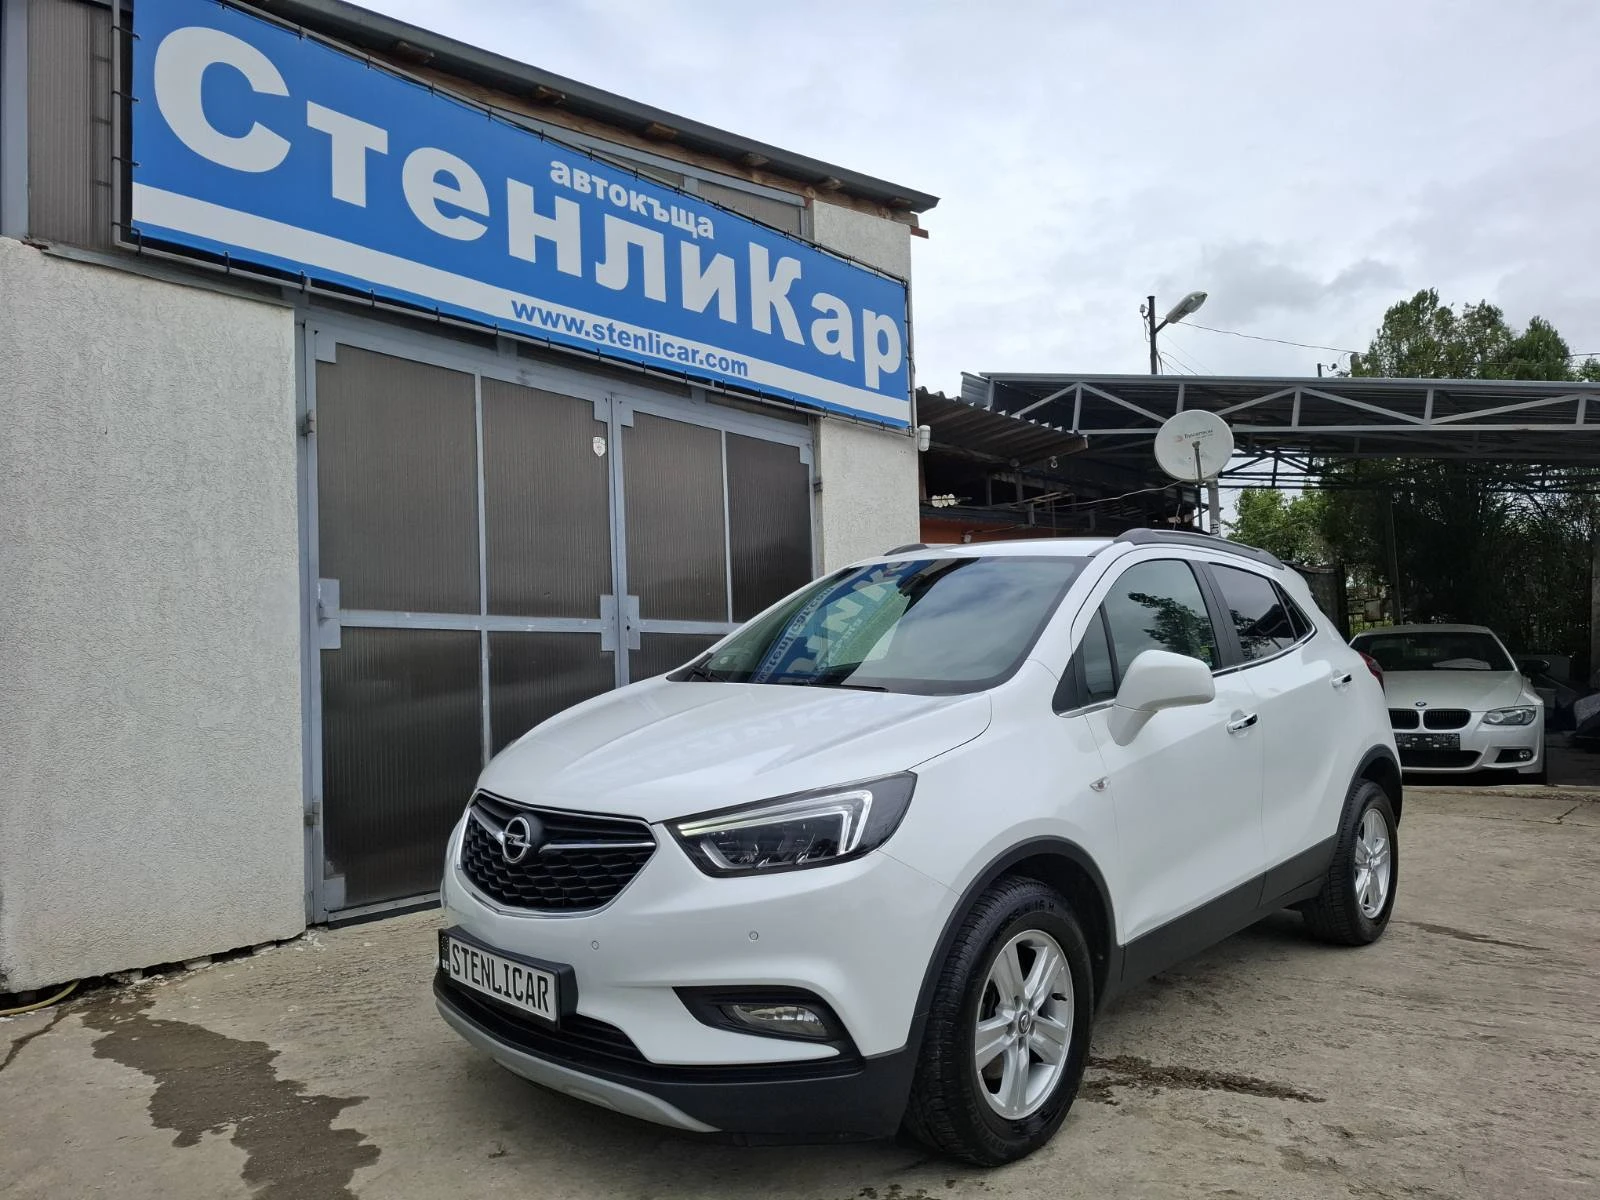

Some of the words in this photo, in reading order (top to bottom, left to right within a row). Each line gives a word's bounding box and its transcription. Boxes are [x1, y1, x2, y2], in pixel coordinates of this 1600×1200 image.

[154, 26, 901, 389] СтенлиКар
[550, 160, 715, 240] автокъща
[511, 300, 748, 377] www.stenlicar.com
[452, 943, 549, 1013] STENLICAR
